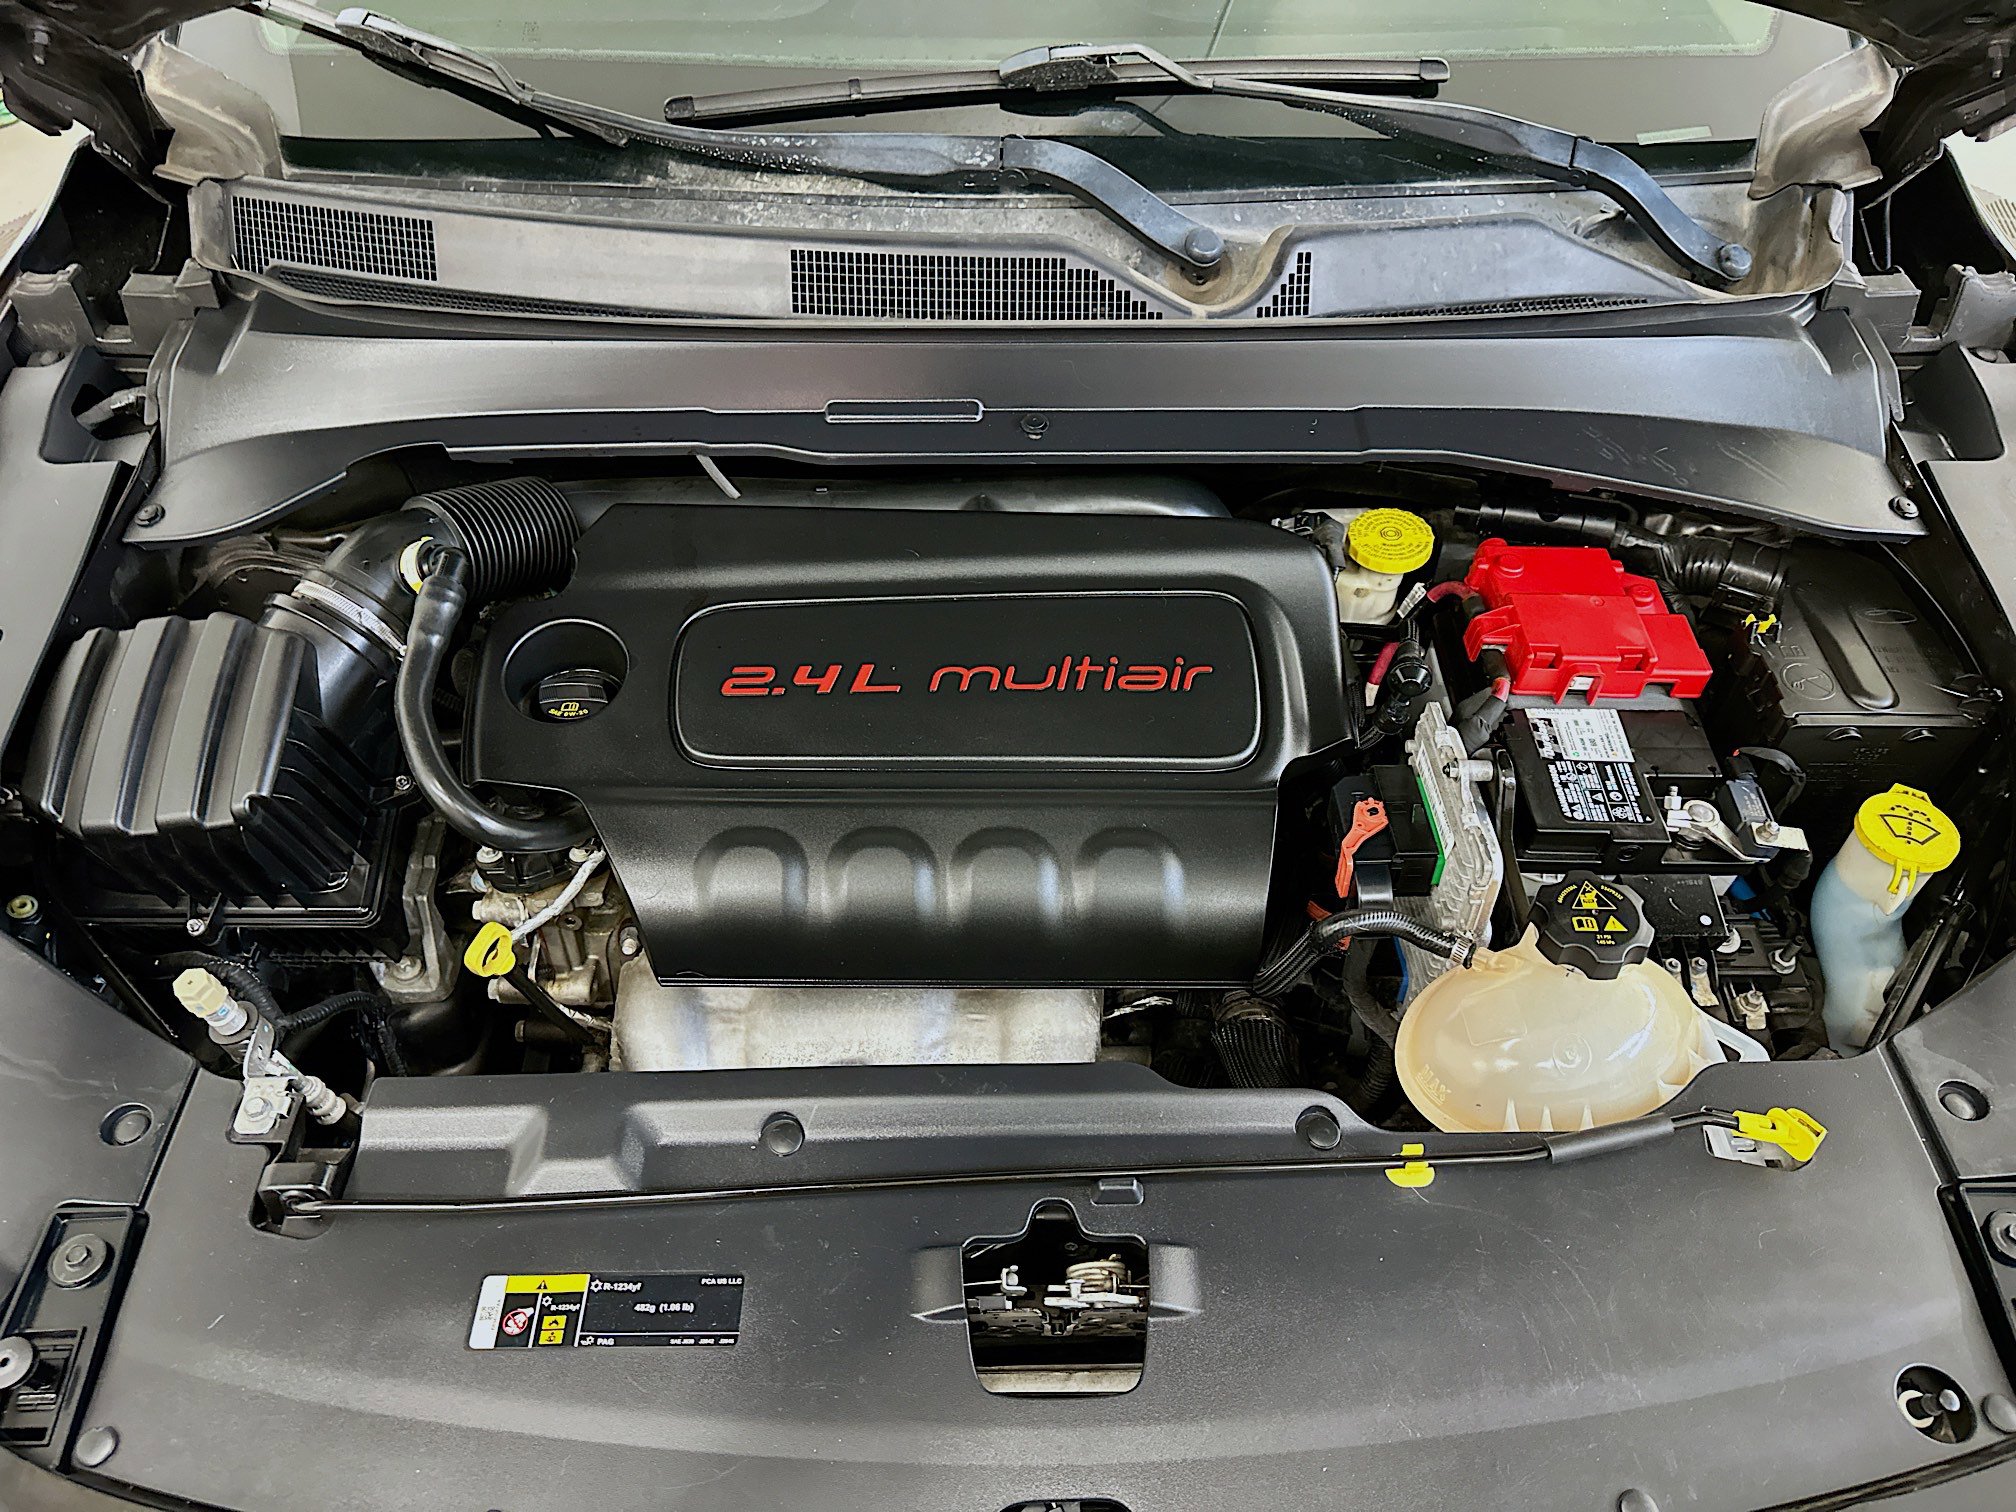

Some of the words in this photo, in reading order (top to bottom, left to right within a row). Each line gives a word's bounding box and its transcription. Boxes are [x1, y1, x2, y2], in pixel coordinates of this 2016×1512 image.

[929, 655, 1213, 693] multiair
[564, 709, 588, 717] 0W-20
[1419, 1064, 1452, 1101] MAX
[728, 1277, 743, 1285] LLC
[603, 1282, 642, 1292] R-1234yf
[682, 1303, 694, 1313] lb)
